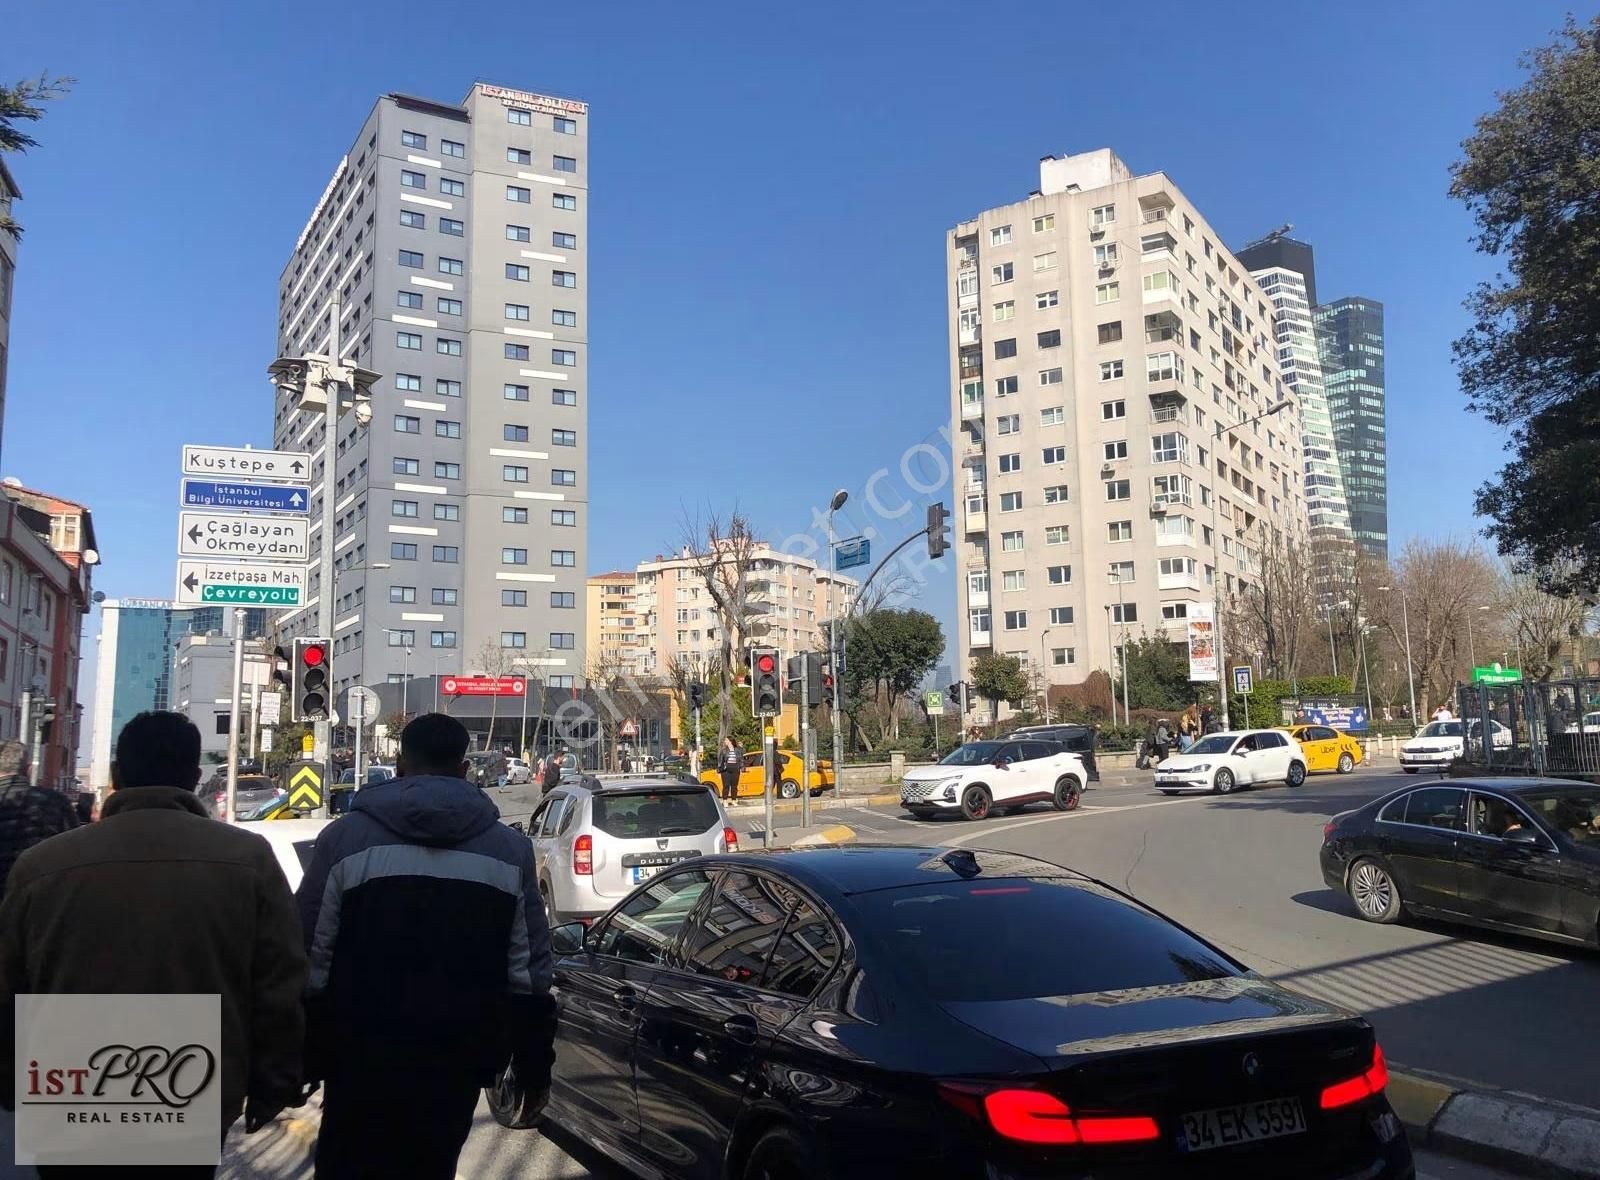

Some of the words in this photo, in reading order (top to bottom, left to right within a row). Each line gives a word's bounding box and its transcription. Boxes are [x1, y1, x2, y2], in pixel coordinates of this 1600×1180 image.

[190, 453, 275, 473] Kuştepe
[214, 484, 262, 496] İstanbul
[189, 494, 214, 505] Bilgi
[218, 494, 284, 508] Üniversitesi
[207, 520, 294, 537] Çağlayan
[206, 538, 303, 555] Okmeydanı
[205, 564, 267, 584] İzzetpaşa
[272, 571, 302, 584] Mah.
[203, 586, 298, 602] Çevreyolu
[640, 856, 686, 865] DUSTER
[639, 867, 650, 878] 34
[1185, 1114, 1215, 1147] 34
[1217, 1109, 1254, 1142] EK
